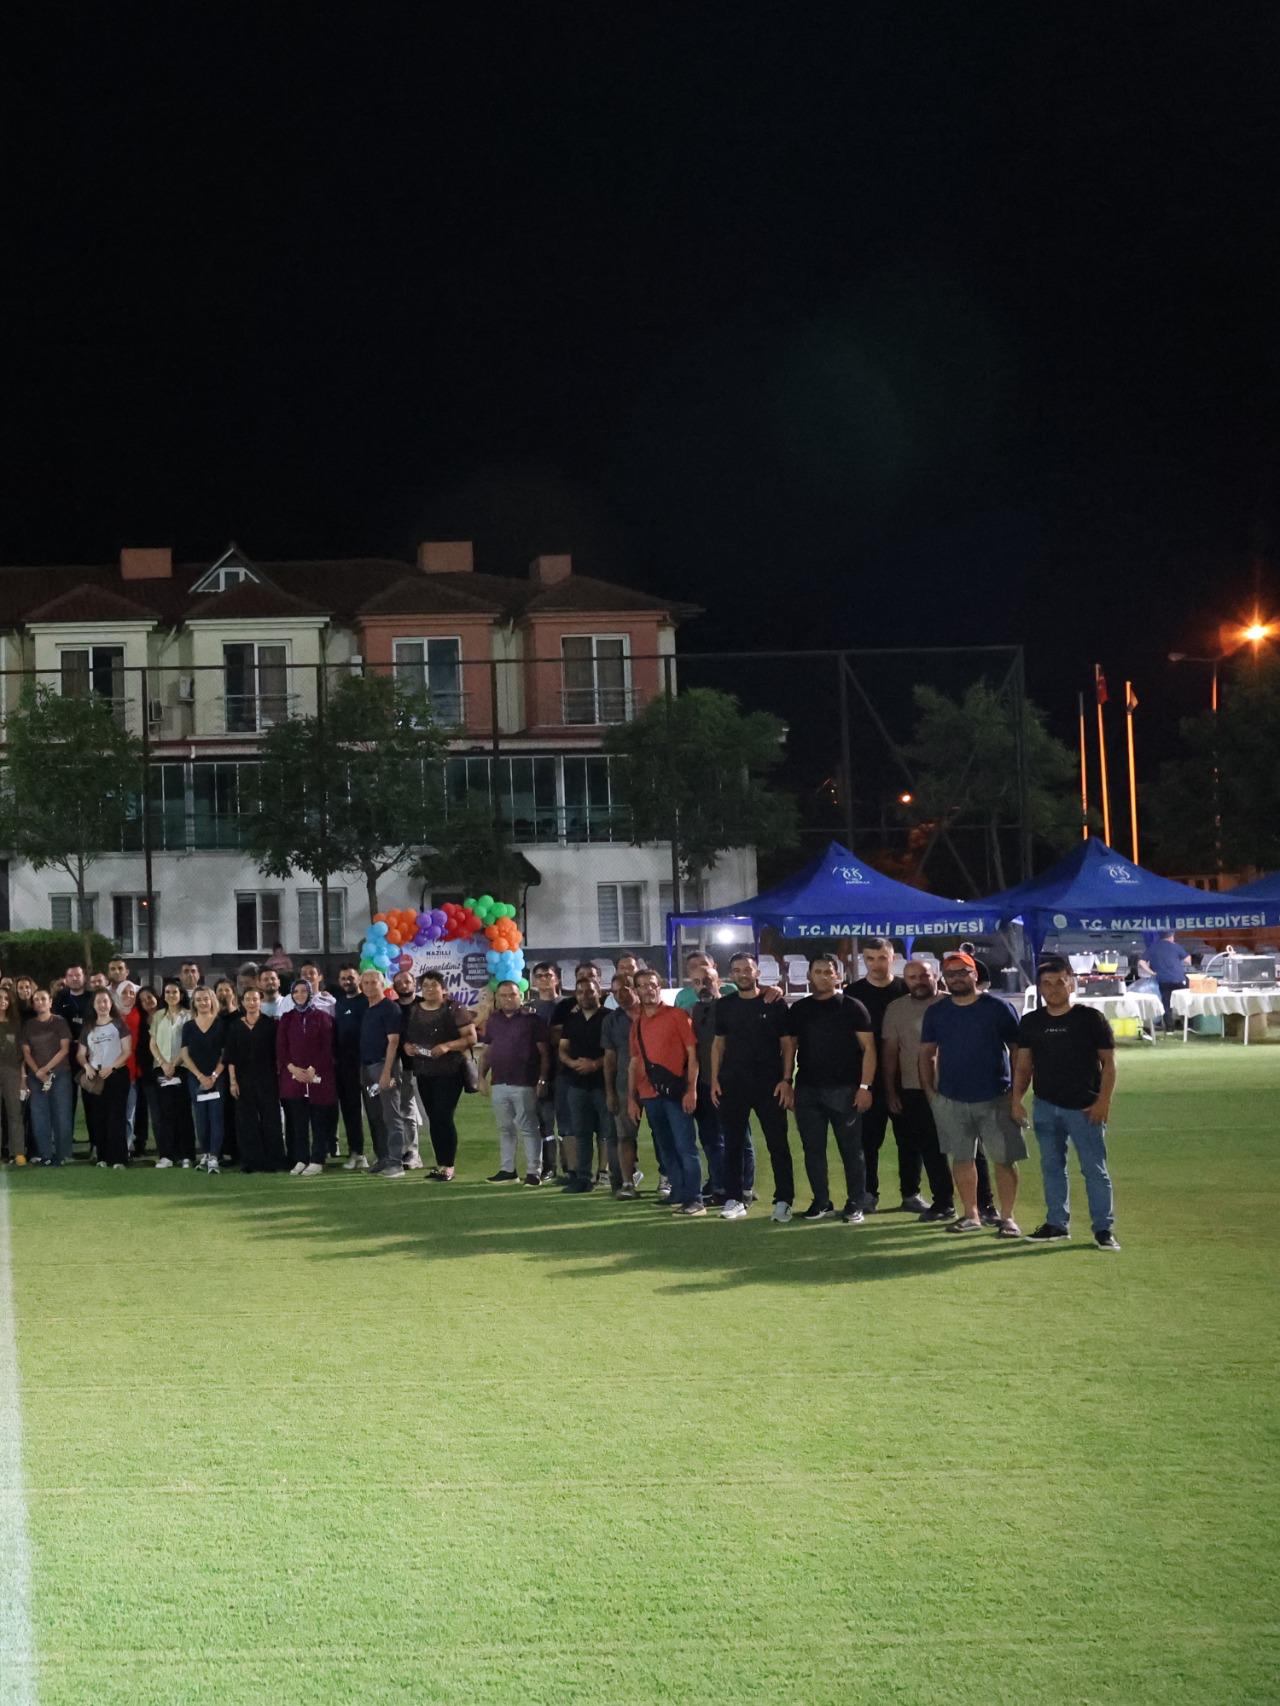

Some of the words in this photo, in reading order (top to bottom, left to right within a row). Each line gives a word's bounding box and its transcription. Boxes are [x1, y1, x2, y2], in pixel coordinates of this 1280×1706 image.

[798, 925, 825, 936] T.C.
[830, 922, 890, 936] NAZİLLİ
[895, 918, 984, 936] BELEDİYESİ
[1111, 916, 1171, 931] NAZİLLİ
[1175, 911, 1266, 930] BELEDİYESİ
